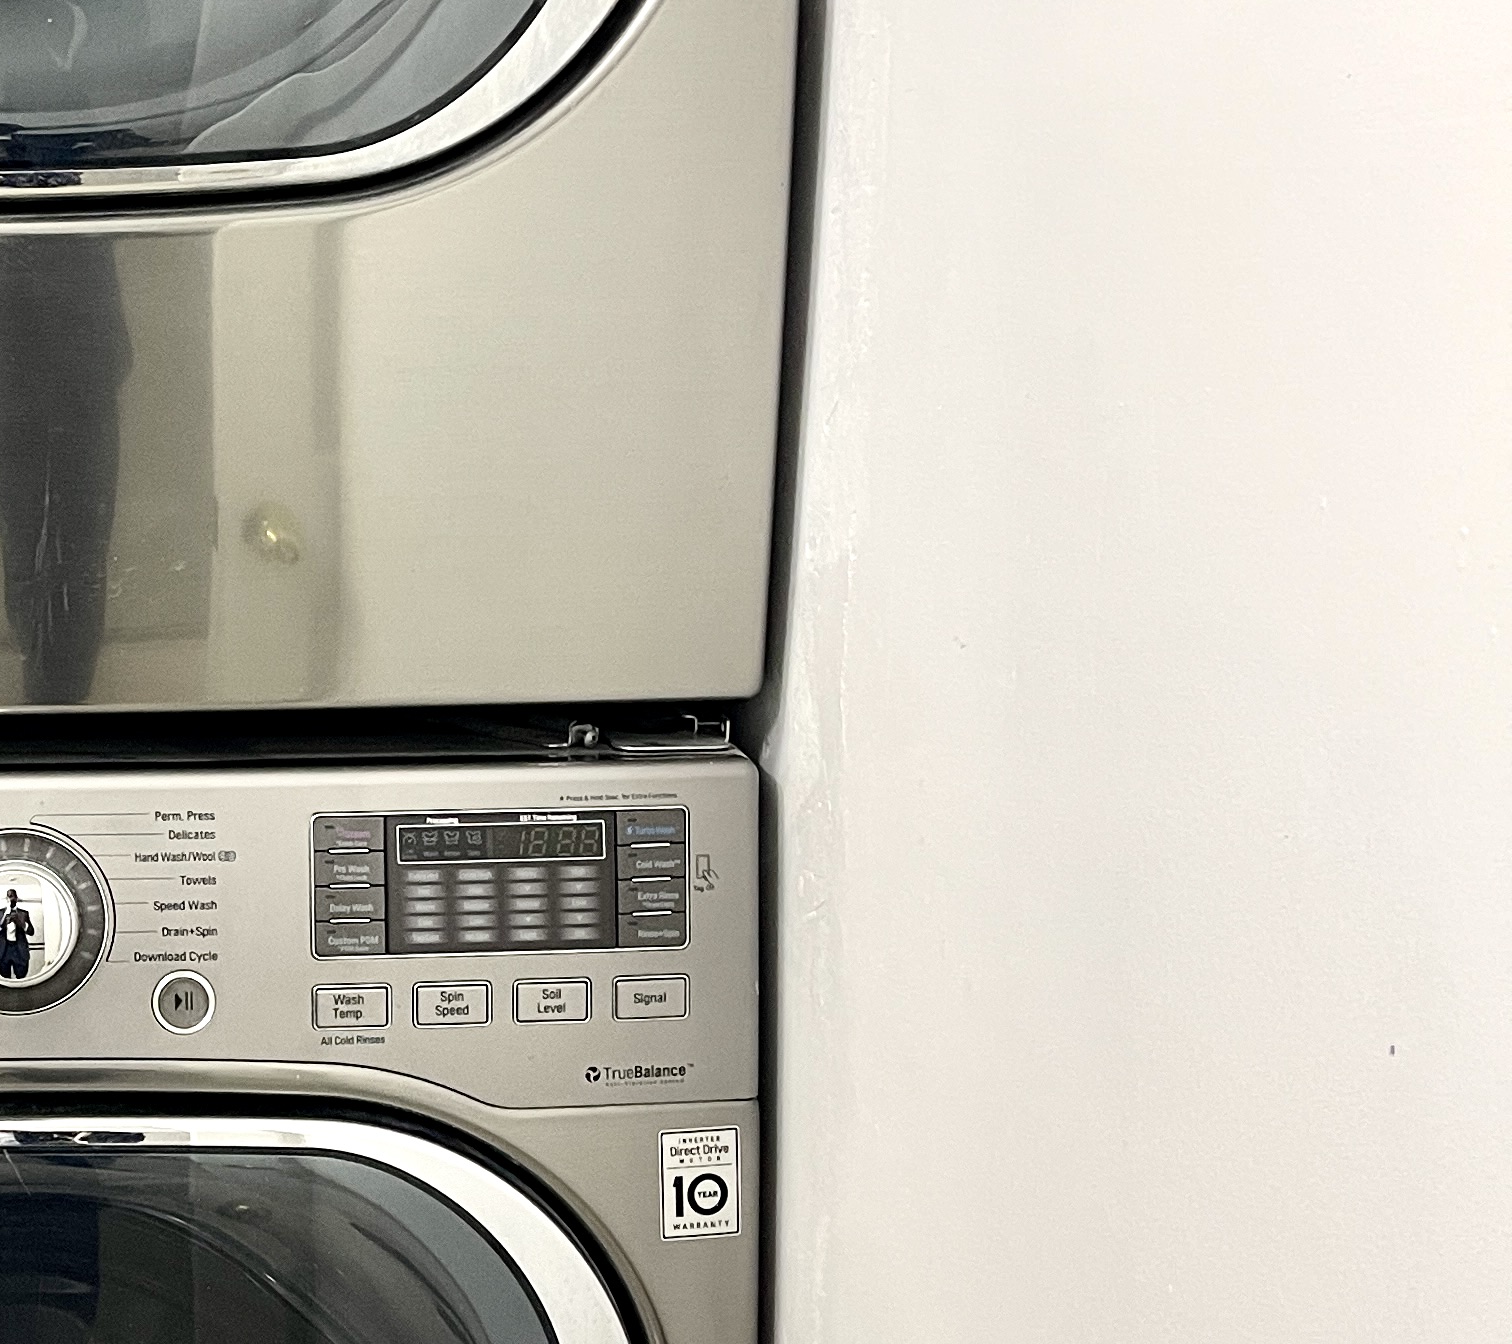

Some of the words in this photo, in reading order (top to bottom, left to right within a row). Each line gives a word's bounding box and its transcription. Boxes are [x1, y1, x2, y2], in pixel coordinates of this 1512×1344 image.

[154, 811, 184, 821] Perm.
[187, 810, 216, 820] Press
[168, 829, 216, 840] Delicates
[134, 852, 159, 862] Hand
[160, 851, 216, 862] Wash/Wool
[179, 875, 217, 885] Towels
[153, 900, 186, 912] Speed
[188, 900, 218, 910] Wash
[161, 926, 218, 938] Drain+Spin
[133, 951, 187, 962] Download
[189, 951, 219, 963] Cycle
[333, 994, 365, 1005] Wash
[440, 991, 464, 1005] Spin
[542, 988, 562, 1000] Soil
[633, 992, 667, 1006] Signal
[435, 1004, 470, 1017] Speed
[537, 1002, 566, 1014] Level
[320, 1037, 332, 1046] All
[334, 1035, 355, 1046] Cold
[356, 1034, 386, 1045] Rinses
[670, 1145, 701, 1157] Direct
[702, 1144, 730, 1155] Drive
[673, 1173, 729, 1218] 10
[673, 1220, 730, 1231] WARRANTY
